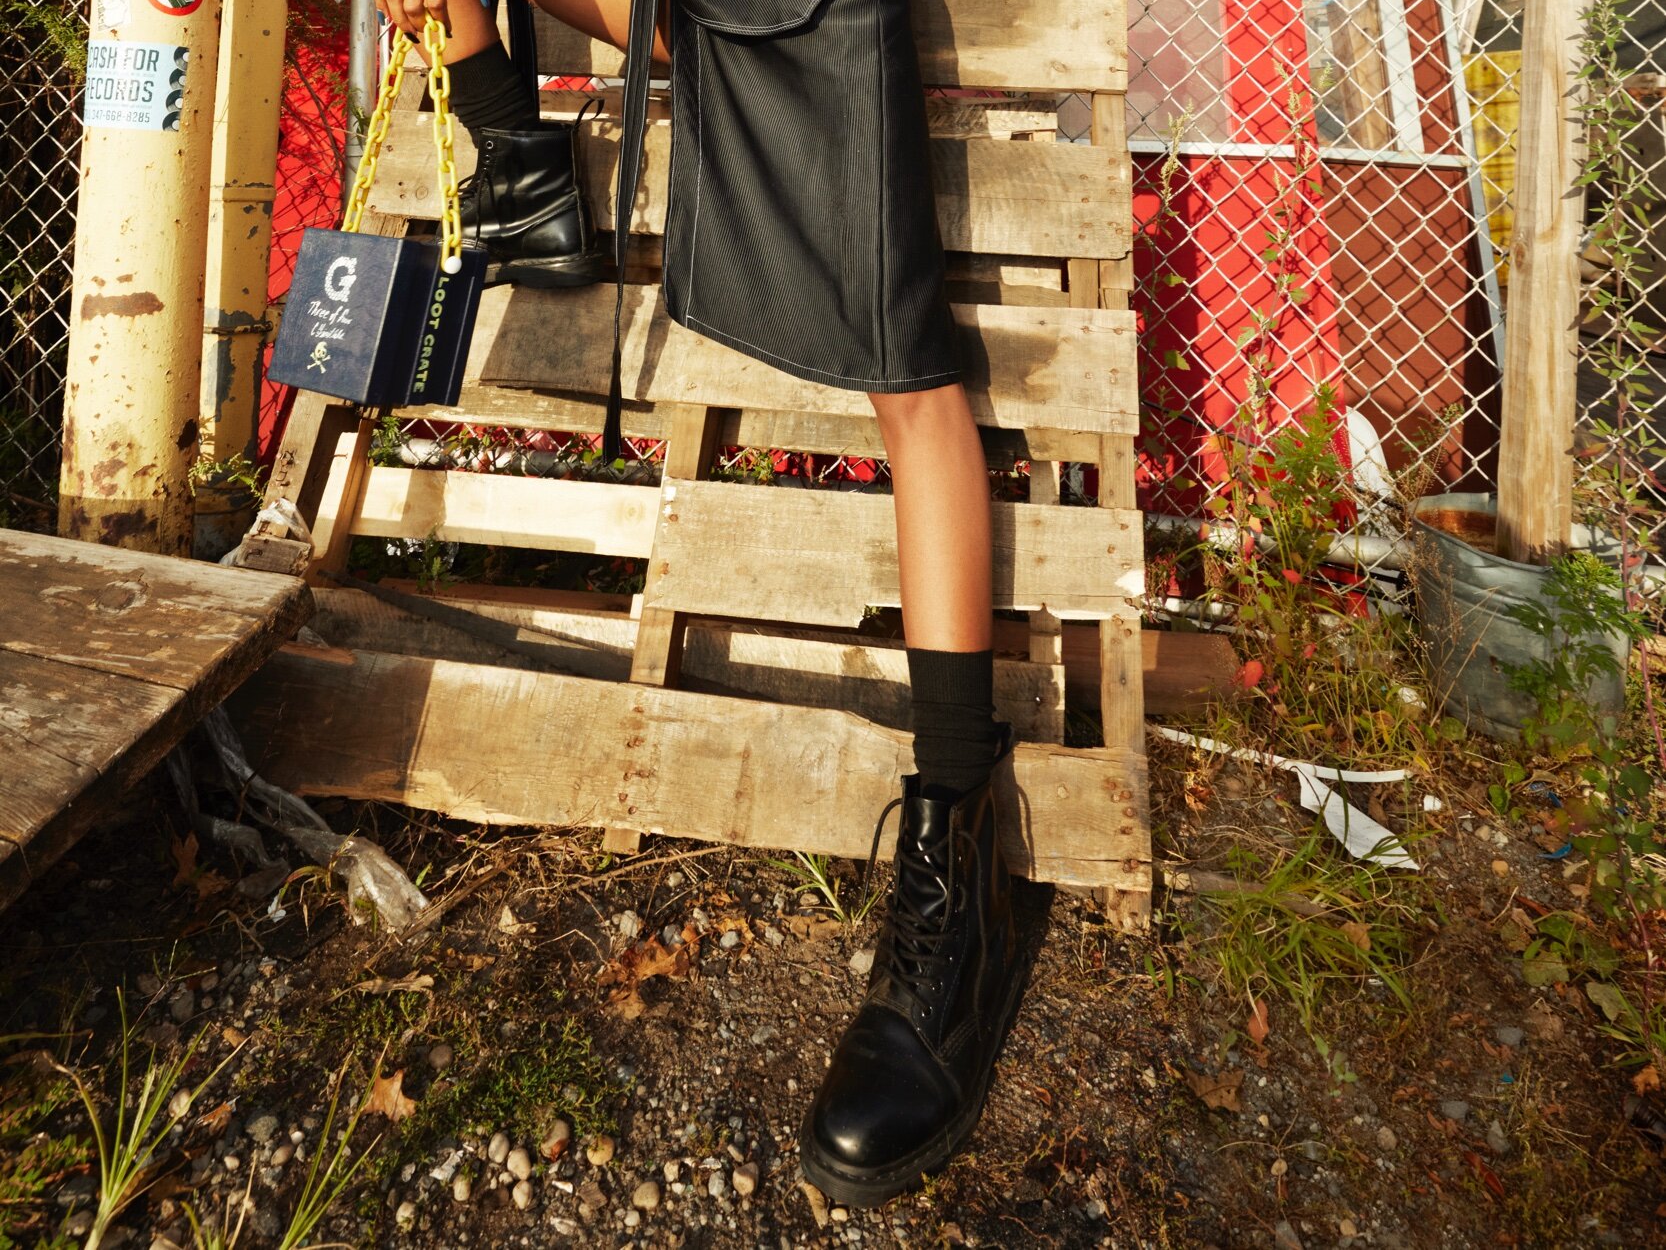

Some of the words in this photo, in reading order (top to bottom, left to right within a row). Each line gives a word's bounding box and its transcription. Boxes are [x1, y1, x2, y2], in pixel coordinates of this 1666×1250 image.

[88, 46, 118, 69] CASH
[123, 47, 160, 72] FOR
[324, 255, 357, 303] G
[429, 276, 450, 330] LOOT
[413, 334, 435, 393] CRATE
